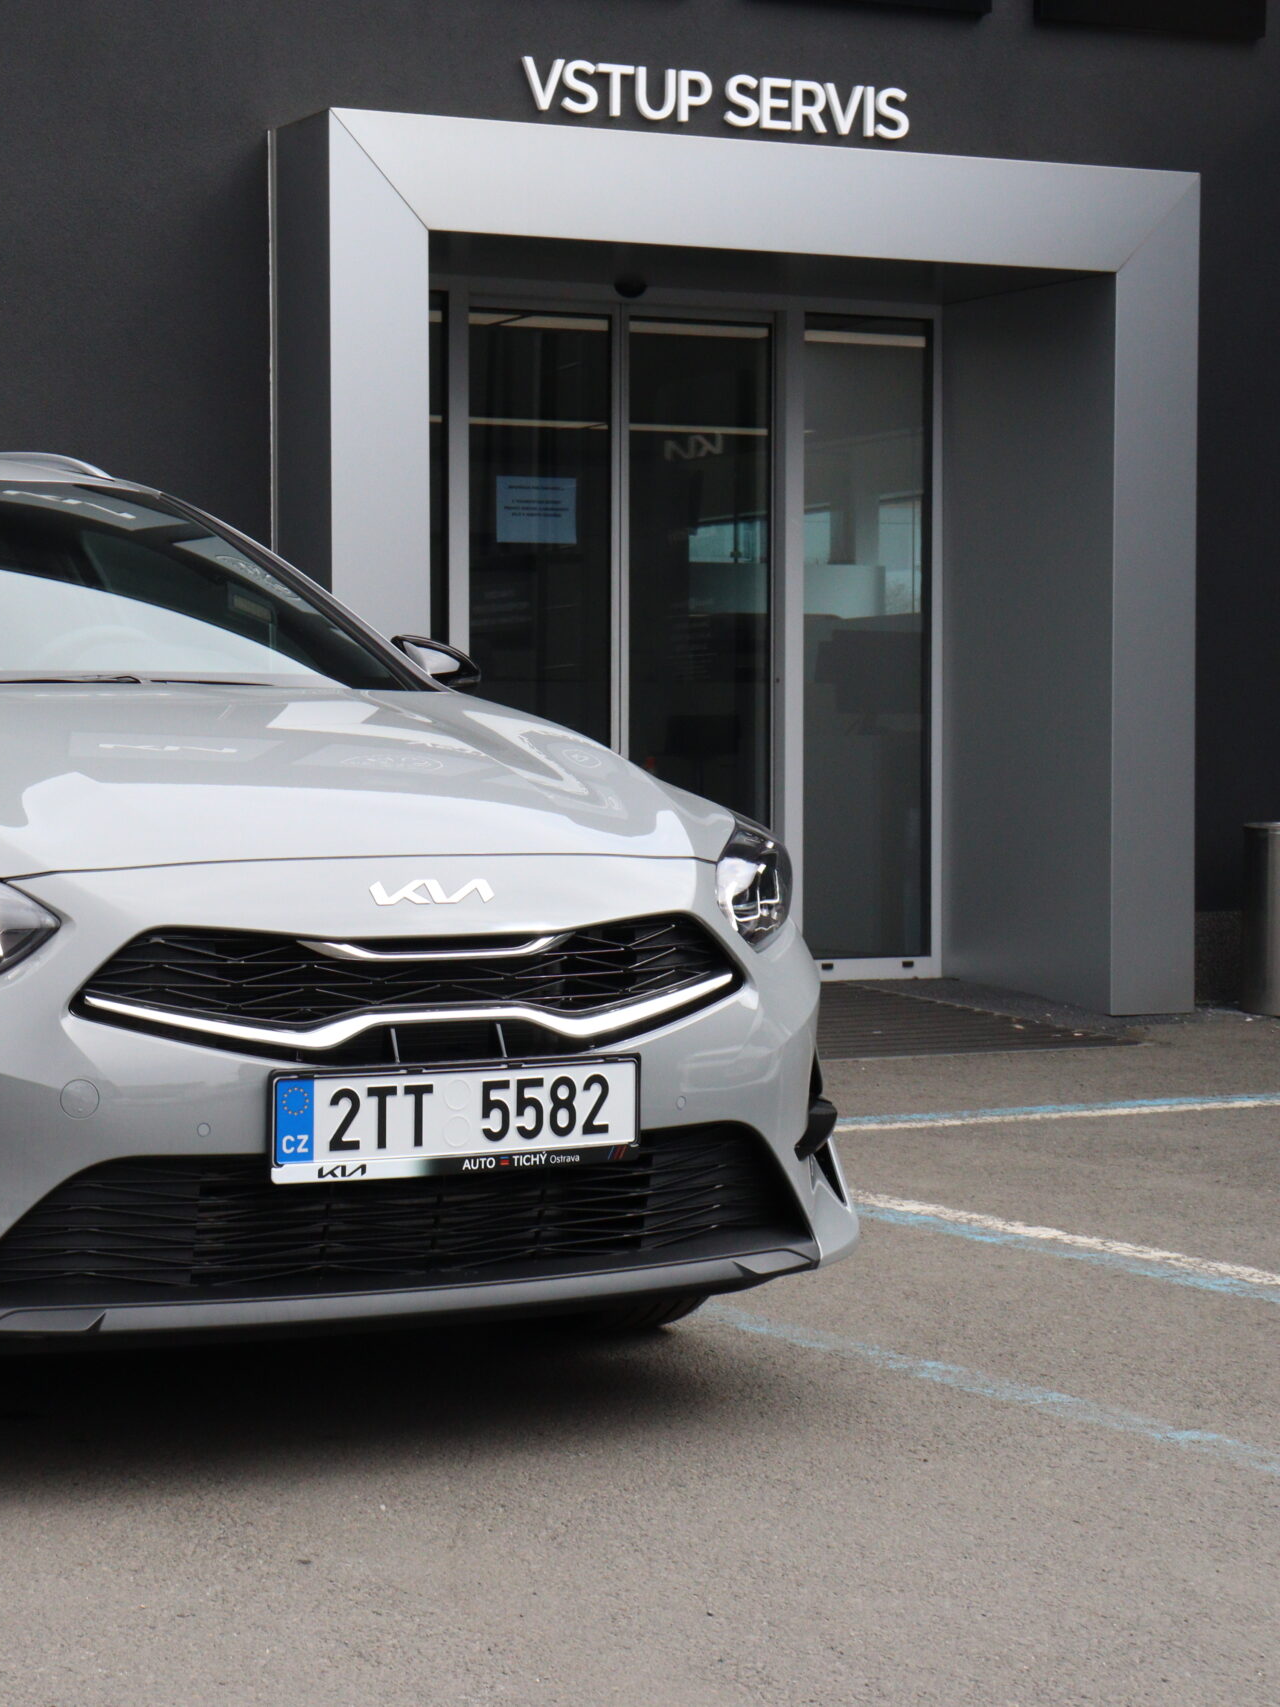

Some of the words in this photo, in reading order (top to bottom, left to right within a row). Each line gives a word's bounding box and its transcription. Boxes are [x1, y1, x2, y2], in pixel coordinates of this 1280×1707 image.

[521, 55, 713, 122] VSTUP
[723, 74, 910, 140] SERVIS
[368, 878, 495, 906] KIA
[328, 1082, 435, 1152] 2TT
[481, 1073, 610, 1142] 5582
[281, 1134, 309, 1155] CZ
[317, 1163, 367, 1179] KIA
[462, 1156, 496, 1171] AUTO
[512, 1151, 548, 1167] TICHÝ
[549, 1153, 580, 1164] Ostrava
